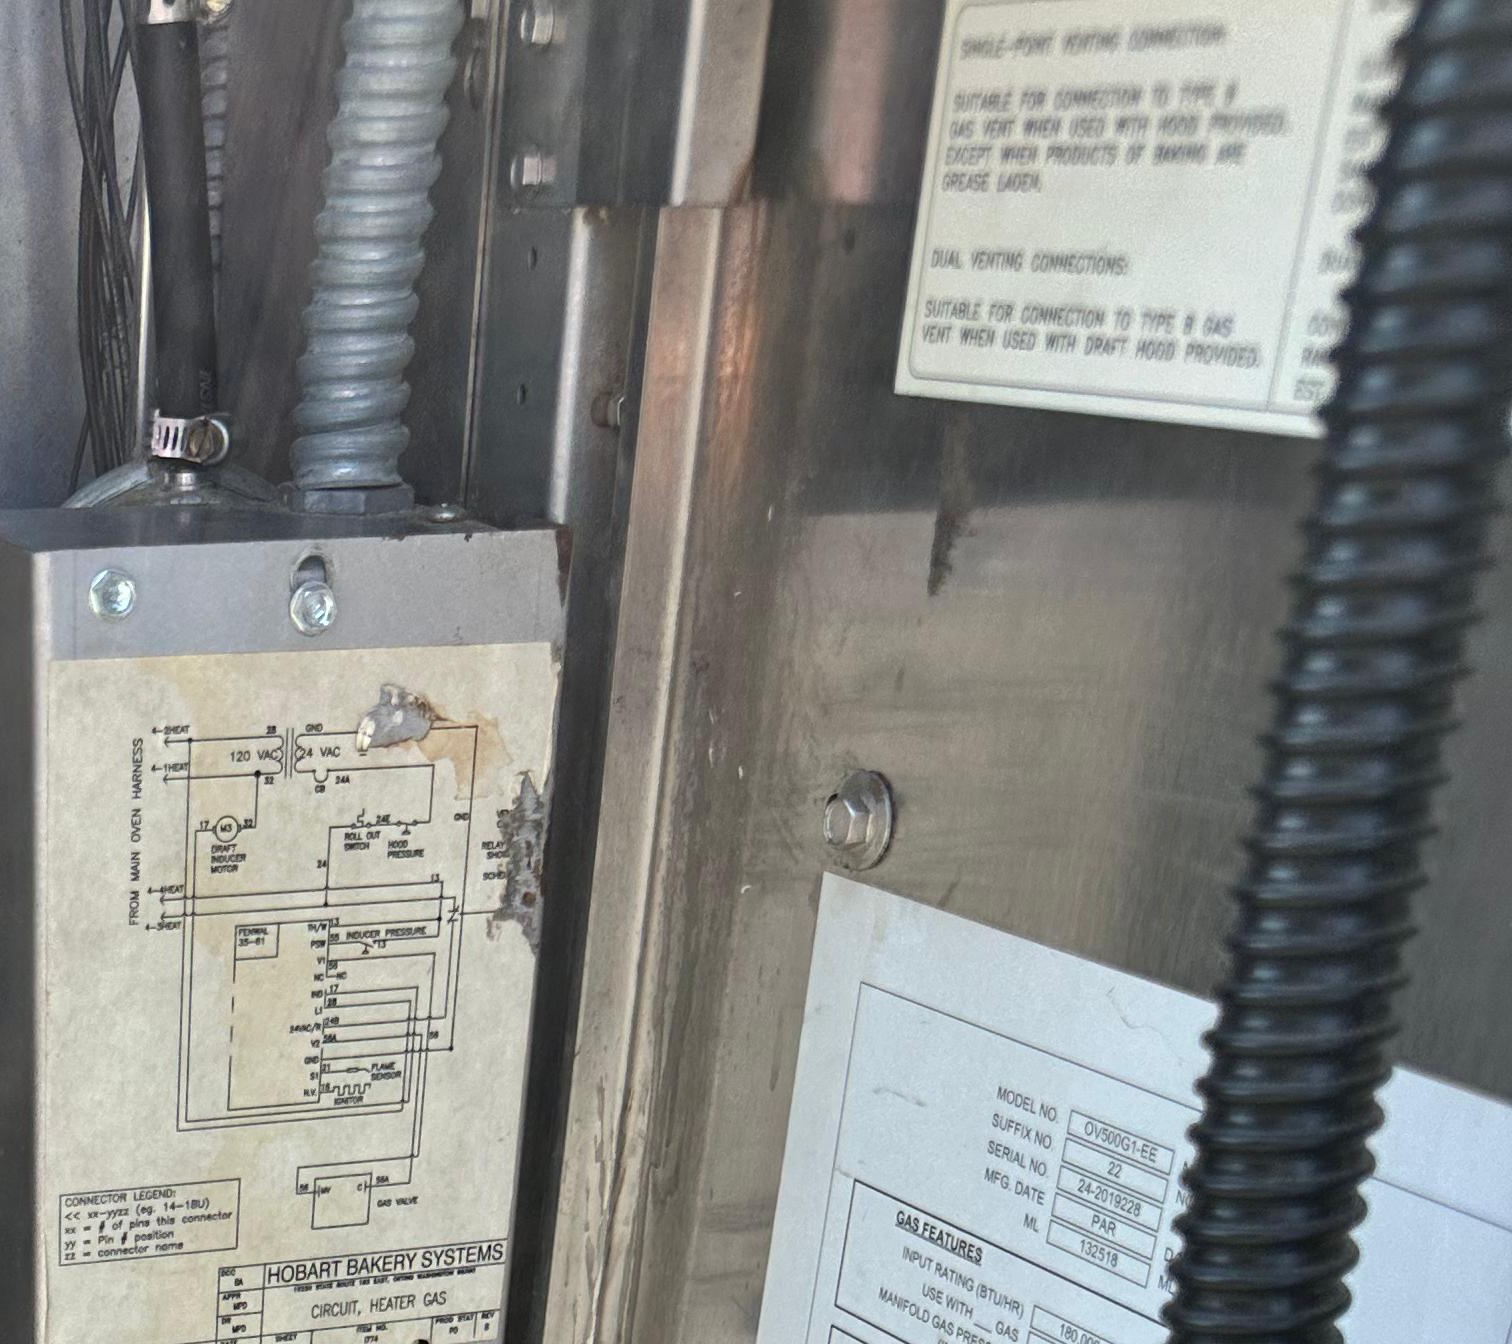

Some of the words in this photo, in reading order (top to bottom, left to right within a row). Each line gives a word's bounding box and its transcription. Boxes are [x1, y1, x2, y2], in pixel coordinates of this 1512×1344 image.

[931, 247, 962, 269] DUAL
[971, 250, 1024, 271] VENTING
[230, 750, 250, 762] 120
[257, 747, 280, 761] VAC
[298, 747, 313, 760] 24
[319, 746, 340, 758] VAC
[132, 738, 143, 799] HARNESS
[131, 809, 141, 842] OVEN
[131, 851, 140, 881] MAIN
[129, 888, 140, 926] FROM
[996, 1086, 1035, 1114] MODEL
[991, 1113, 1032, 1140] SUFFIX
[987, 1140, 1025, 1168] SERIAL
[1084, 1121, 1157, 1163] OV500G1-EE
[1107, 1161, 1122, 1179] 22
[64, 1192, 127, 1207] CONNECTOR
[984, 1167, 1012, 1189] MFG.
[1014, 1180, 1044, 1205] DATE
[1077, 1178, 1141, 1217] 24-2019228
[895, 1210, 919, 1235] GAS
[920, 1222, 982, 1262] FEATURES
[1023, 1213, 1038, 1232] ML
[1091, 1214, 1116, 1236] PAR
[267, 1260, 342, 1284] HOBART
[346, 1252, 417, 1275] BAKERY
[421, 1243, 503, 1268] SYSTEMS
[1080, 1239, 1118, 1267] 132518
[902, 1246, 933, 1270] INPUT
[934, 1262, 974, 1292] RATING
[976, 1283, 1023, 1318] (BTU/HR)
[311, 1299, 361, 1319] CIRCUIT,
[369, 1294, 416, 1312] HEATER
[423, 1290, 447, 1307] GAS
